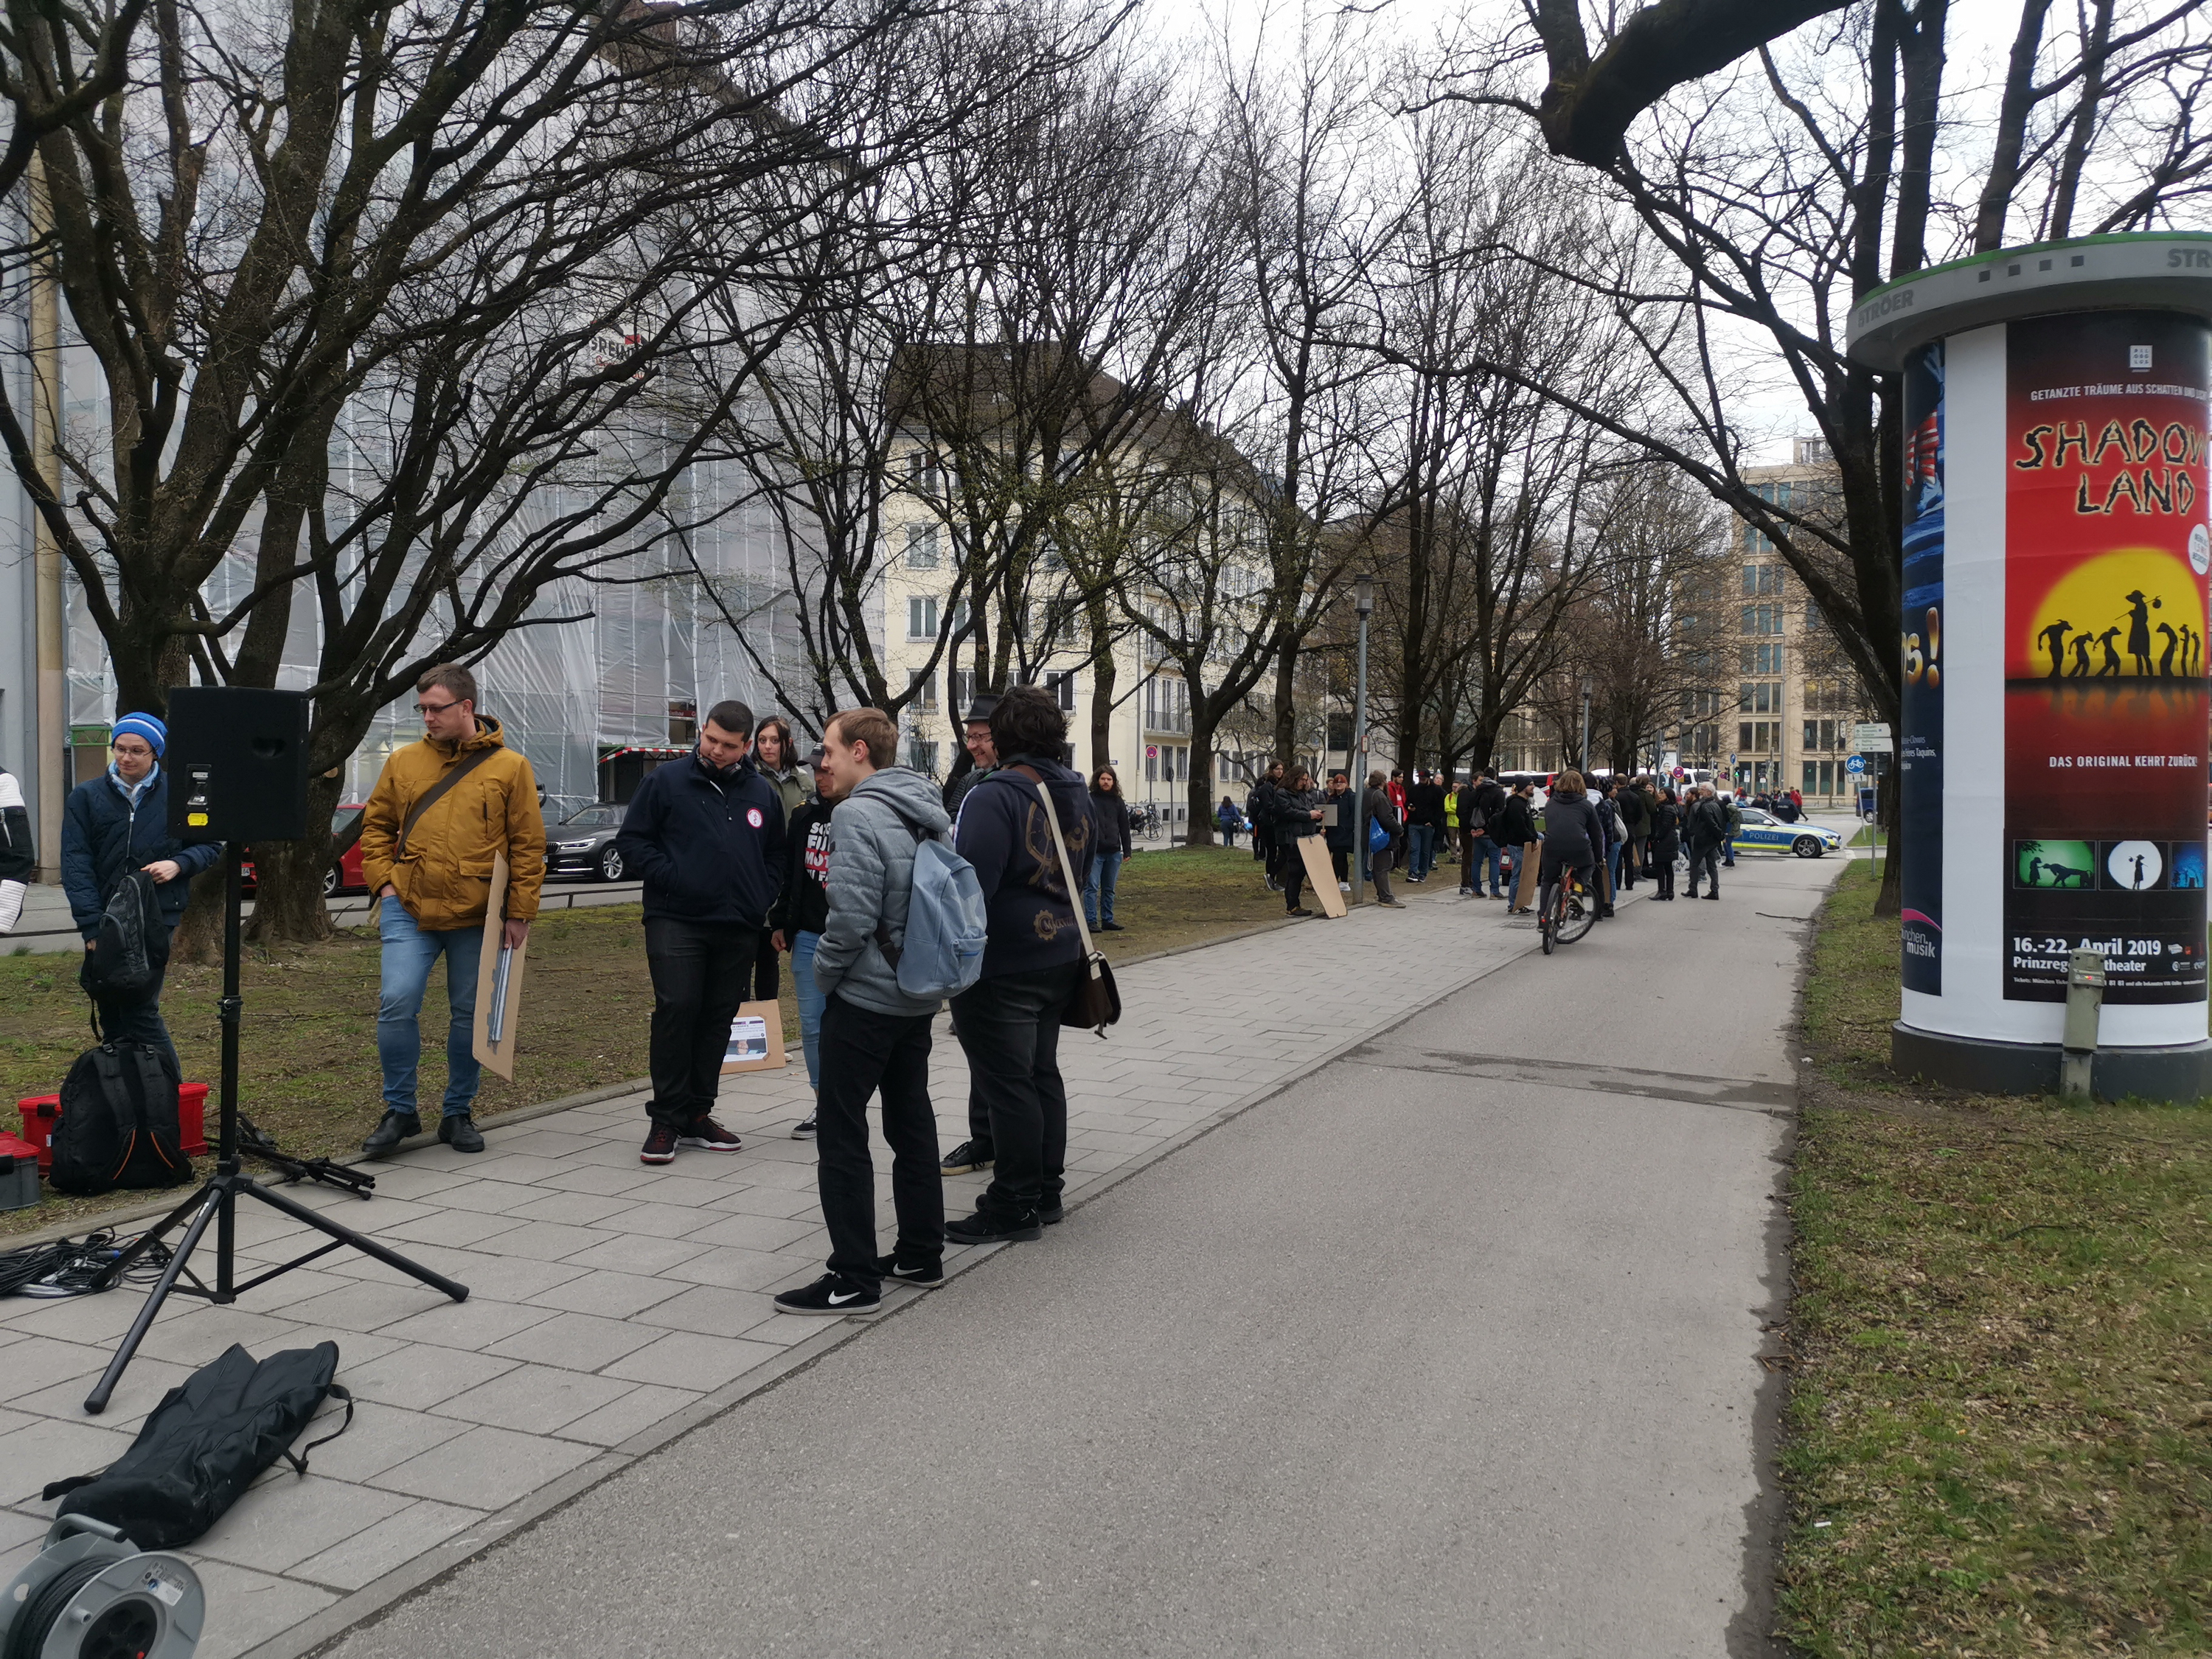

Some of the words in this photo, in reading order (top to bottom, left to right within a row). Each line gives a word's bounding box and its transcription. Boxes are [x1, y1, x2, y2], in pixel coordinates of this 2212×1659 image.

[2167, 248, 2212, 268] STR
[1858, 289, 1913, 328] STRÖER
[2031, 386, 2081, 401] GETANZTE
[2083, 383, 2123, 396] TRÄUME
[2125, 383, 2144, 394] AUS
[2145, 383, 2183, 396] SCHATTEN
[2014, 418, 2208, 470] SHADOW
[2076, 468, 2196, 515] LAND
[2049, 756, 2073, 768] DAS
[2076, 755, 2131, 768] ORIGINAL
[2135, 755, 2166, 767] KEHRT
[2168, 754, 2198, 768] ZURÜCK!
[1749, 832, 1779, 841] POLIZEI
[804, 850, 830, 869] MOT
[1907, 941, 1936, 959] musik
[2013, 937, 2073, 954] 16.-22.
[2127, 939, 2162, 956] 2019
